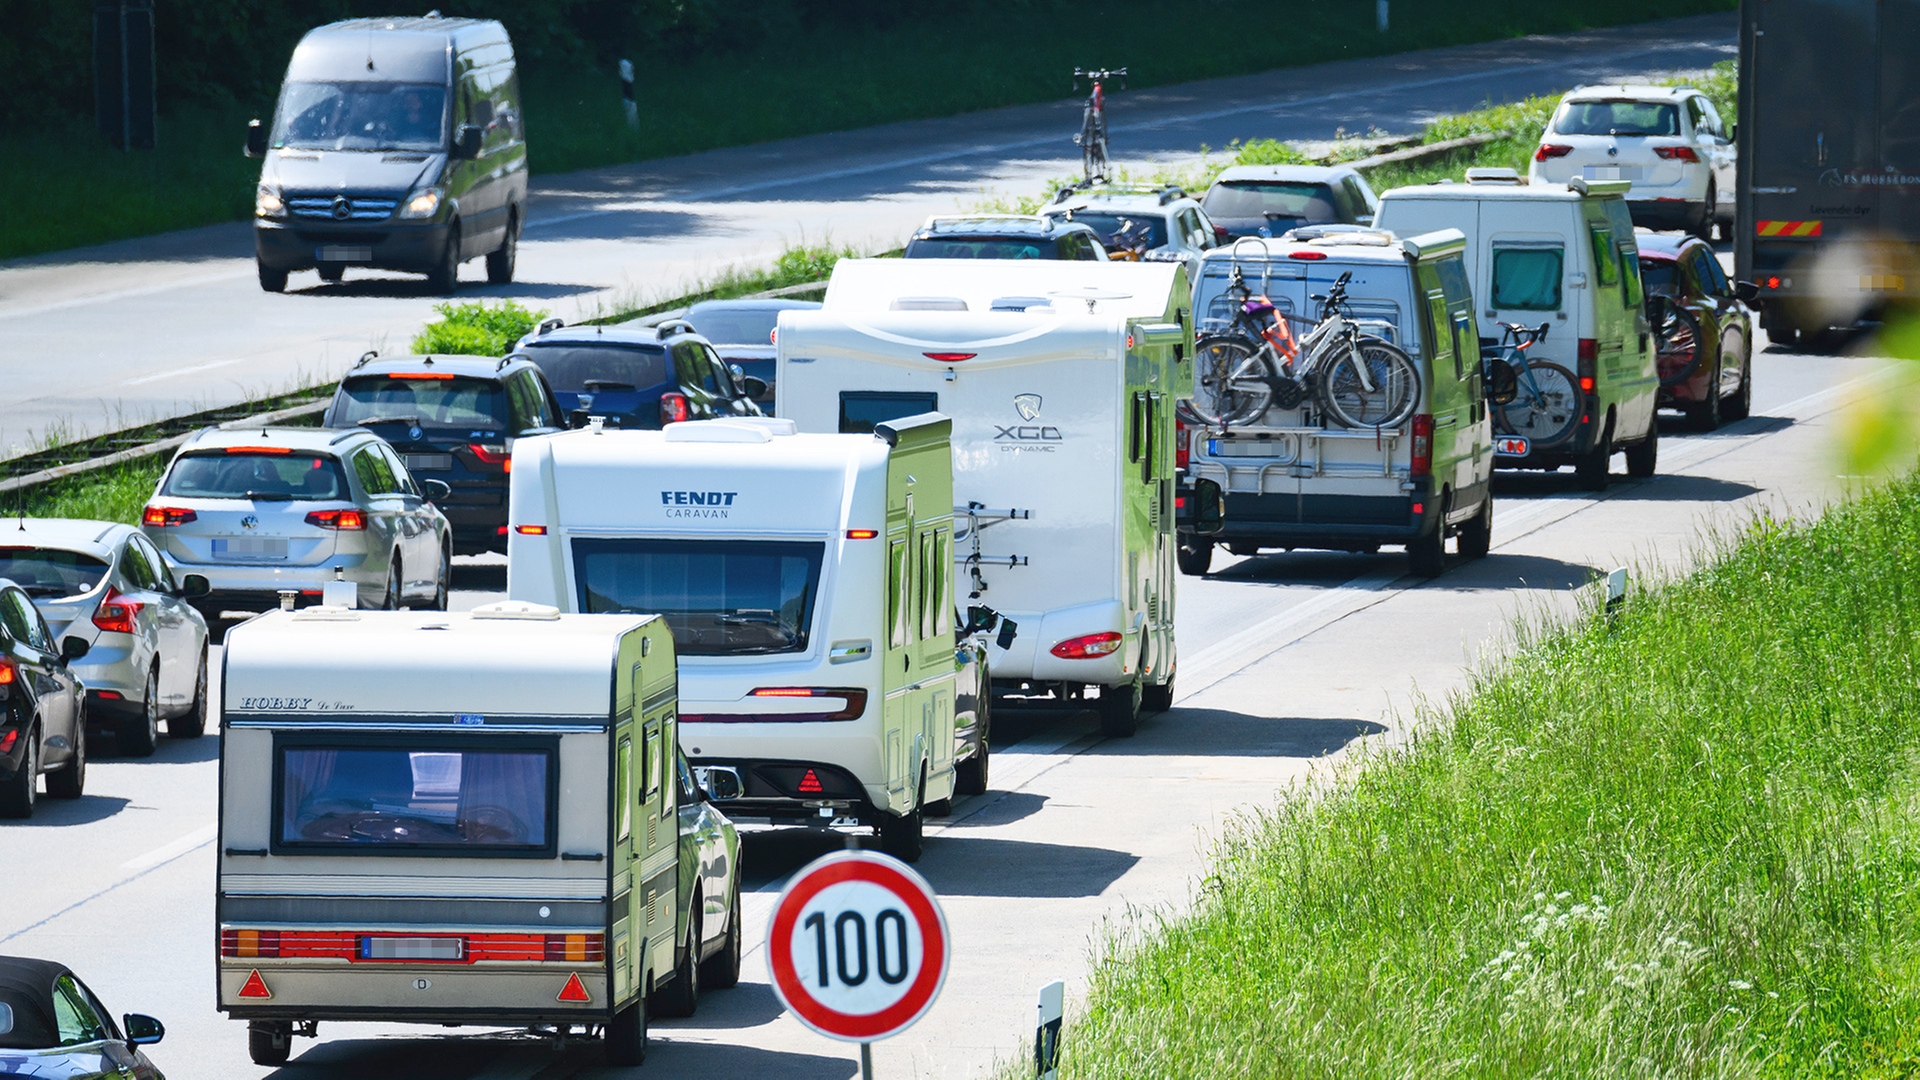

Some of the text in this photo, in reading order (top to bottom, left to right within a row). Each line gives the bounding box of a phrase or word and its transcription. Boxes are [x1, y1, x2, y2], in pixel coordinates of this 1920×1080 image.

[994, 425, 1063, 440] XGO
[1001, 445, 1055, 453] DYNAMIC
[661, 491, 738, 506] FENDT
[666, 509, 728, 518] CARAVAN
[240, 697, 313, 710] HOBBY
[804, 908, 909, 988] 100
[417, 979, 427, 990] D
